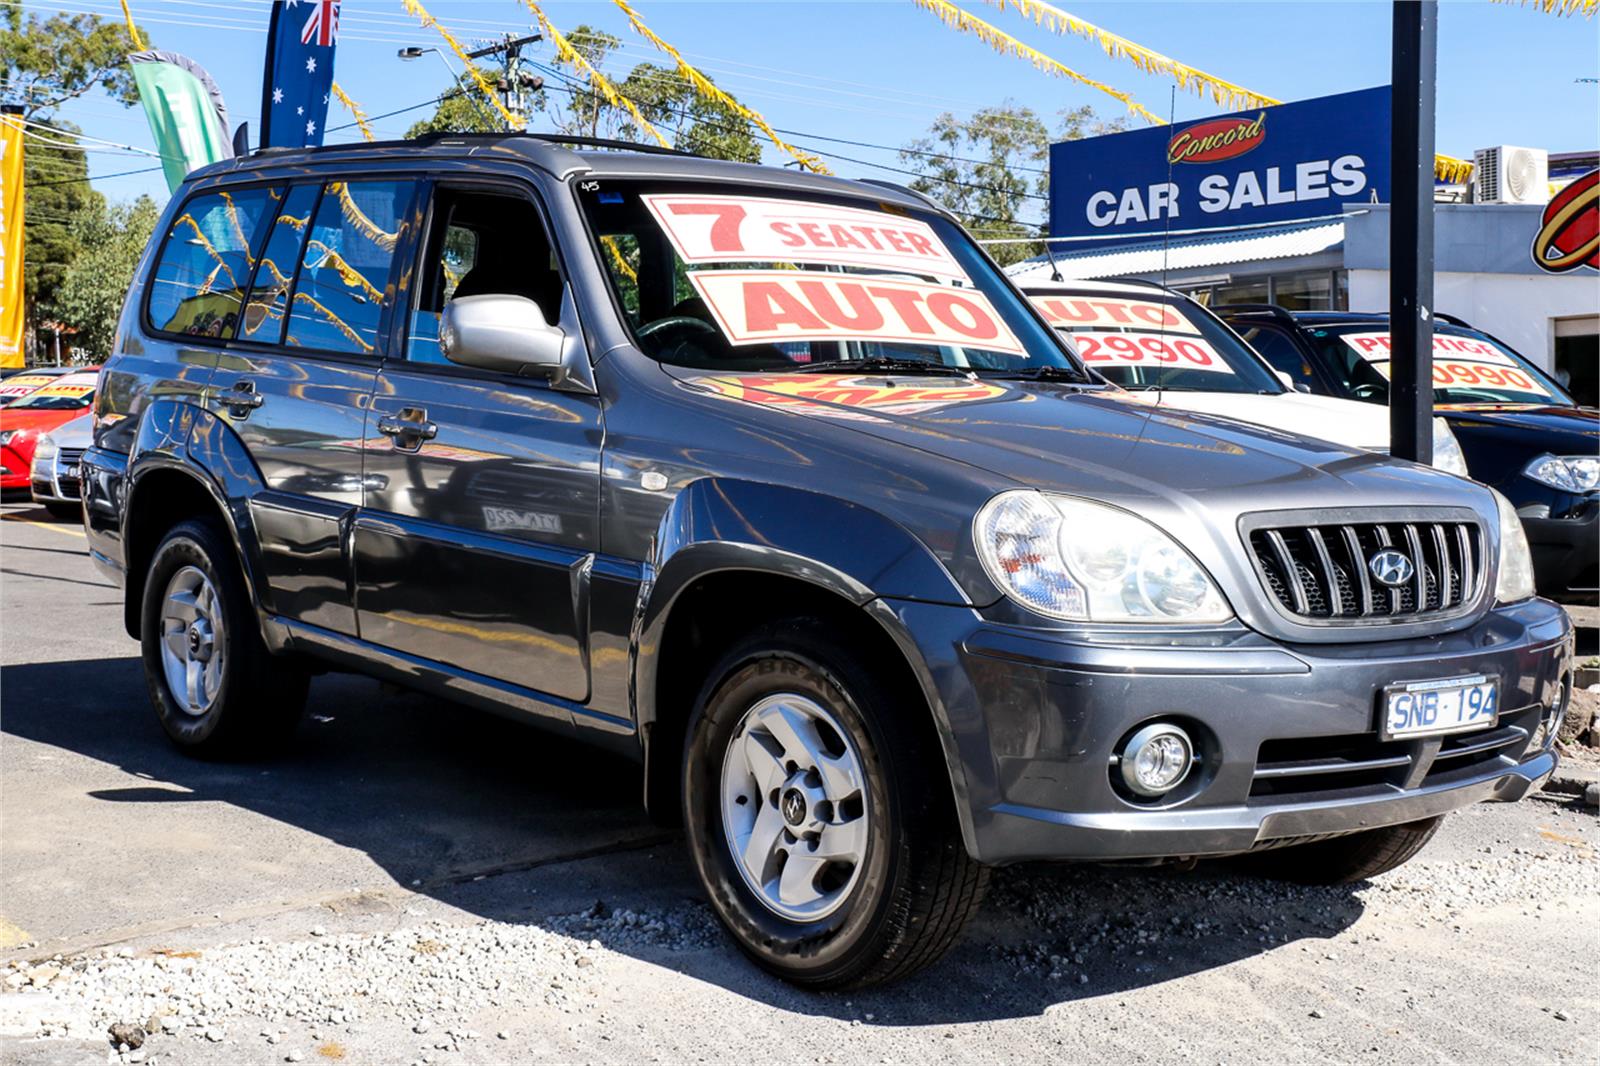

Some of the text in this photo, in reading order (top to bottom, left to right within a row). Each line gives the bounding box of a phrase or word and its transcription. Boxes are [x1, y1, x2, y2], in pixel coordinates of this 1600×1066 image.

[1168, 112, 1266, 163] Concord
[1086, 155, 1367, 227] CAR SALES
[667, 203, 942, 257] 7 SEATER
[742, 281, 999, 340] AUTO
